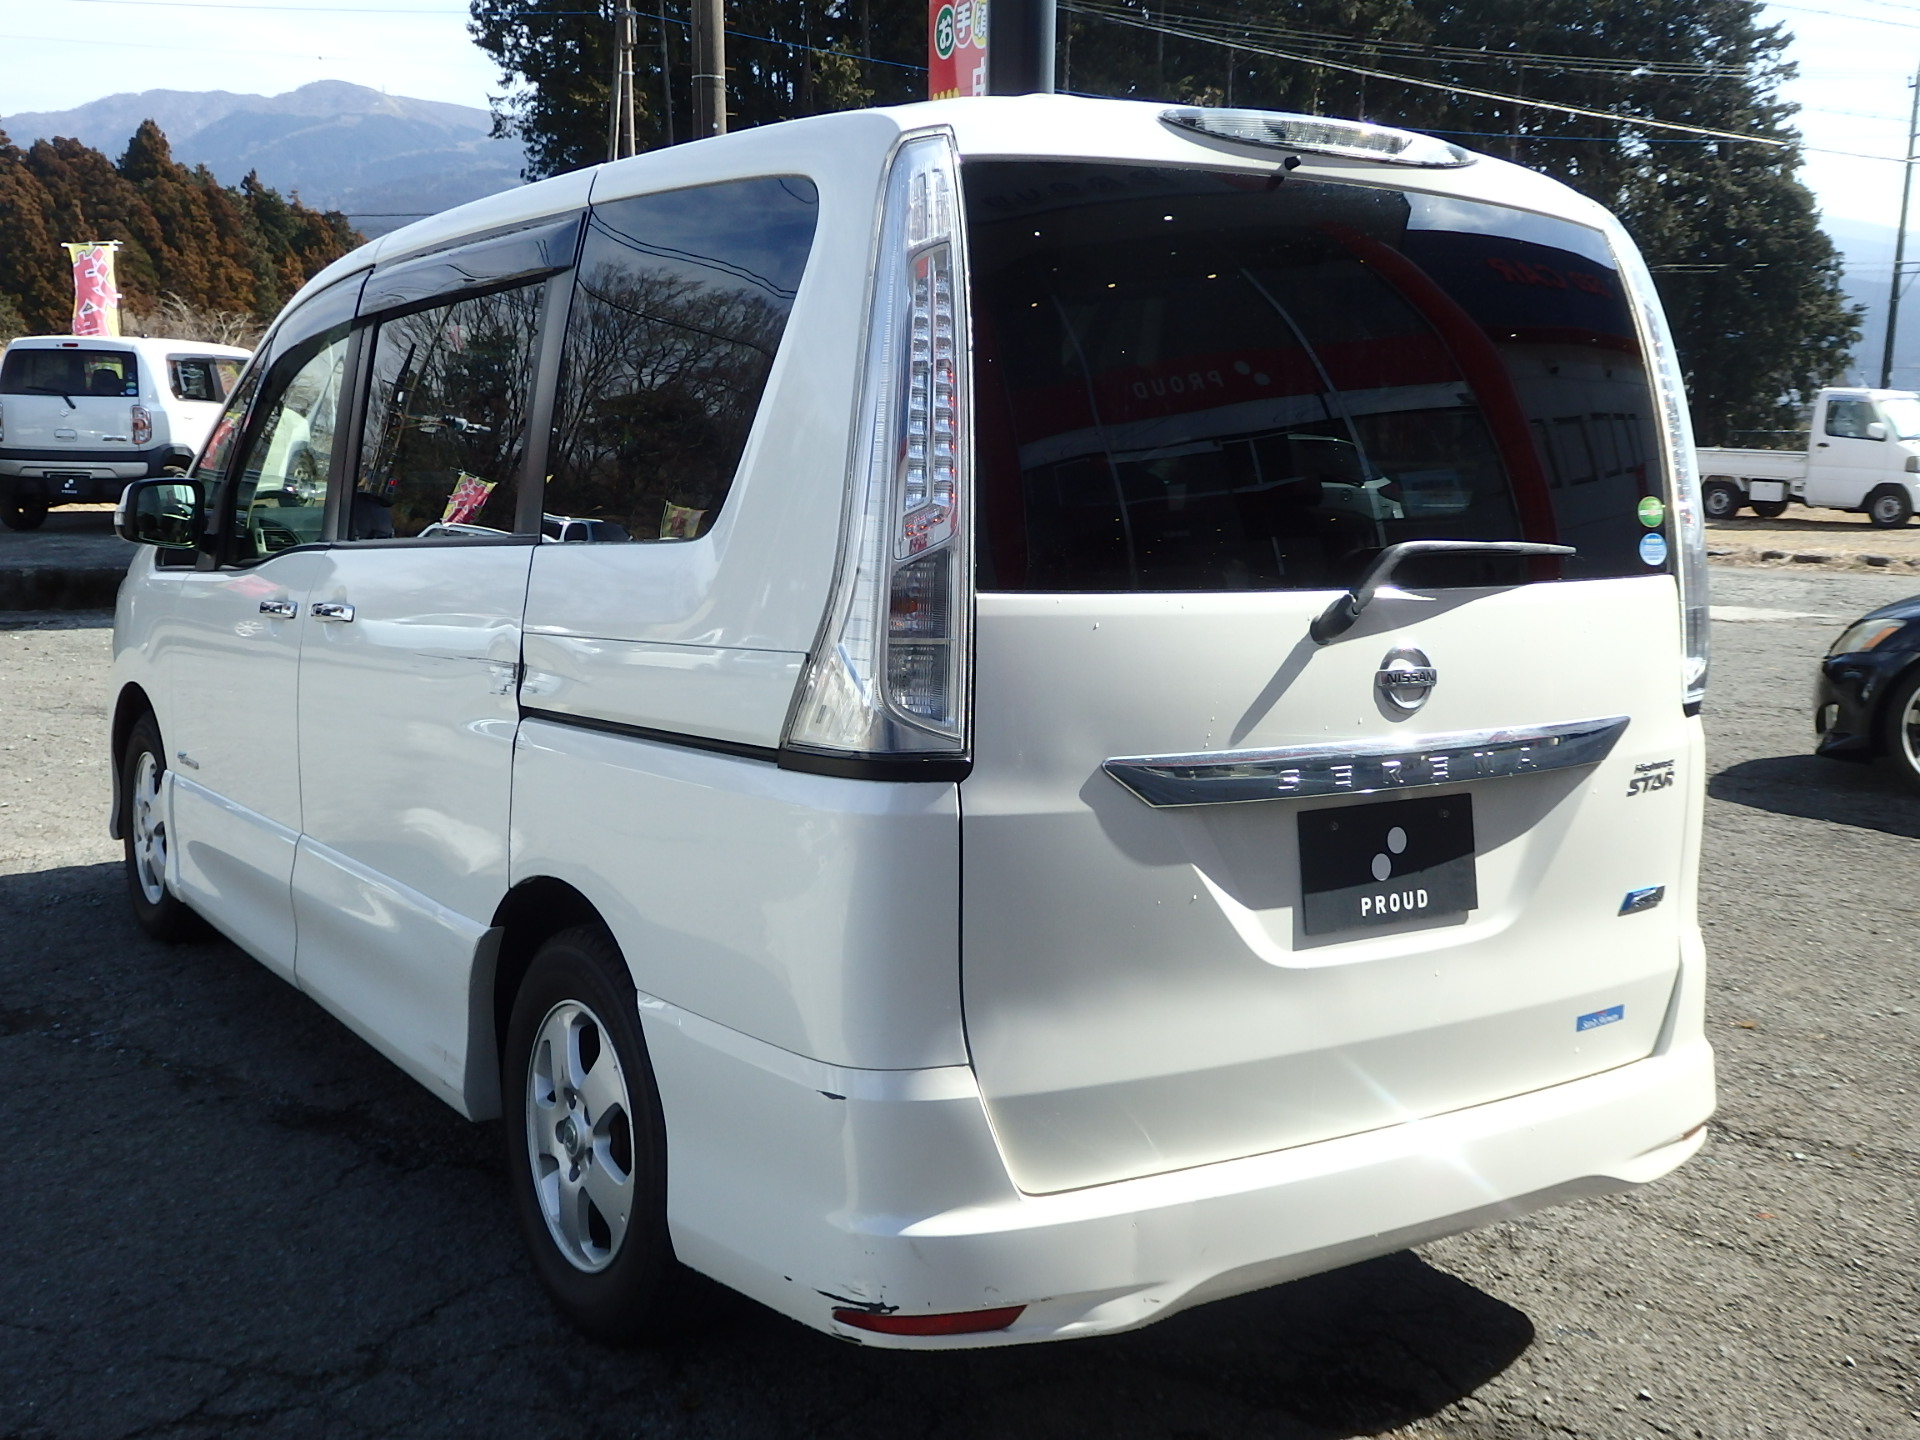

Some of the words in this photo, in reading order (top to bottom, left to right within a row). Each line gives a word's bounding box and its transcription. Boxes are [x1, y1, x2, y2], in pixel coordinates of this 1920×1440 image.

[1386, 671, 1434, 684] NISSAN
[1277, 747, 1538, 791] SERENA
[1626, 771, 1675, 797] STAR
[1360, 888, 1429, 917] PROUD
